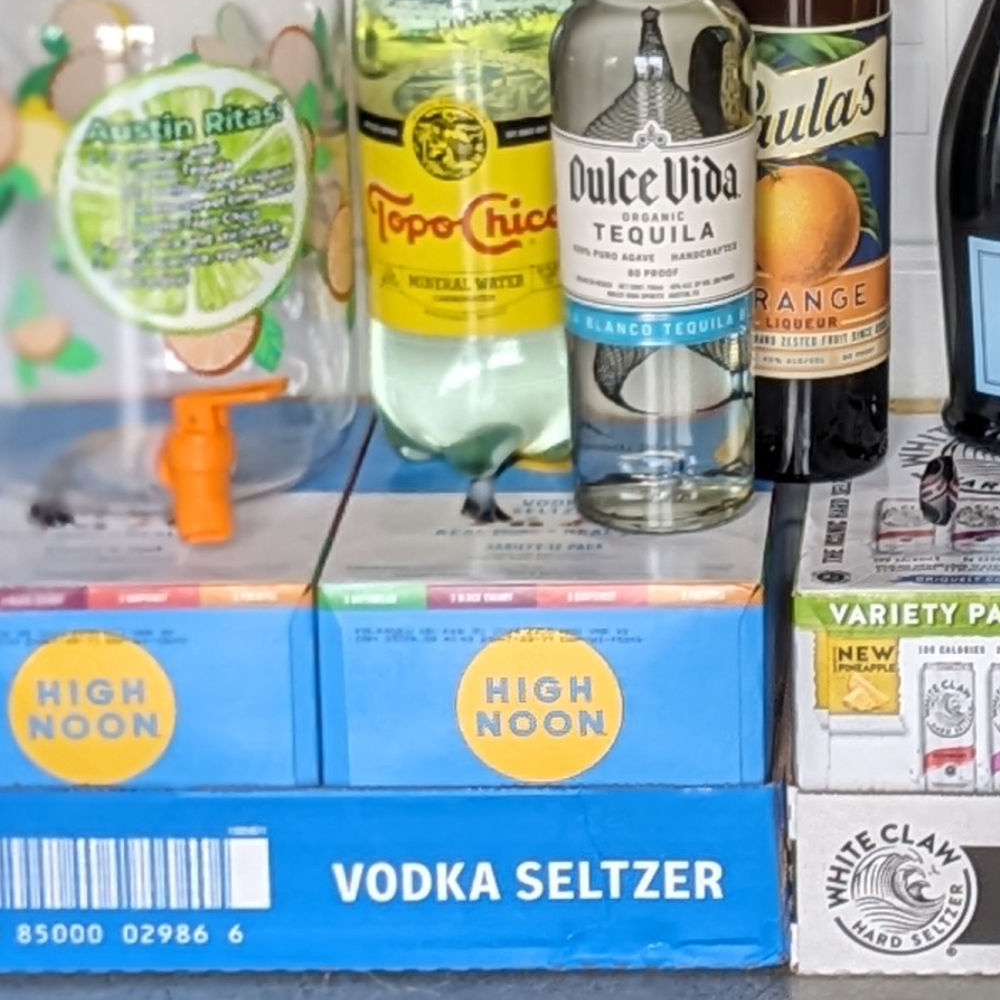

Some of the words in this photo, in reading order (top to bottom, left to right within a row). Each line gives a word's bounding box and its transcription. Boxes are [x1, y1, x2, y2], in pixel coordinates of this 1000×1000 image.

[85, 111, 197, 143] Austin
[570, 154, 658, 206] Dulce
[664, 154, 737, 205] Vida
[368, 181, 462, 245] Topo
[622, 211, 685, 223] ORGANIC
[593, 221, 714, 246] TEQUILA
[622, 253, 655, 263] AGAVE
[408, 274, 467, 291] MINERAL
[476, 274, 524, 291] WATER
[643, 268, 678, 277] PROOF
[754, 283, 866, 312] RANGE
[586, 315, 651, 336] BLANCO
[663, 313, 734, 336] TEQUILA
[766, 317, 838, 330] LIQUEUR
[781, 336, 817, 347] ZESTED
[822, 334, 848, 346] FRUIT
[829, 602, 957, 625] VARIETY
[838, 646, 895, 661] NEW
[918, 645, 935, 654] 100
[939, 645, 985, 654] CALORIES
[839, 664, 895, 673] PINEAPPLE
[37, 678, 146, 706] HIGH
[486, 676, 592, 703] HIGH
[28, 713, 159, 739] NOON
[476, 710, 605, 737] NOON
[825, 829, 876, 909] WHITE
[880, 823, 962, 866] CLAW
[331, 861, 501, 903] VODKA
[516, 860, 724, 900] SELTZER
[852, 919, 902, 949] HARD
[911, 883, 964, 947] SELTZER
[16, 924, 103, 944] 85000
[122, 924, 208, 944] 02986
[228, 924, 244, 944] 6
